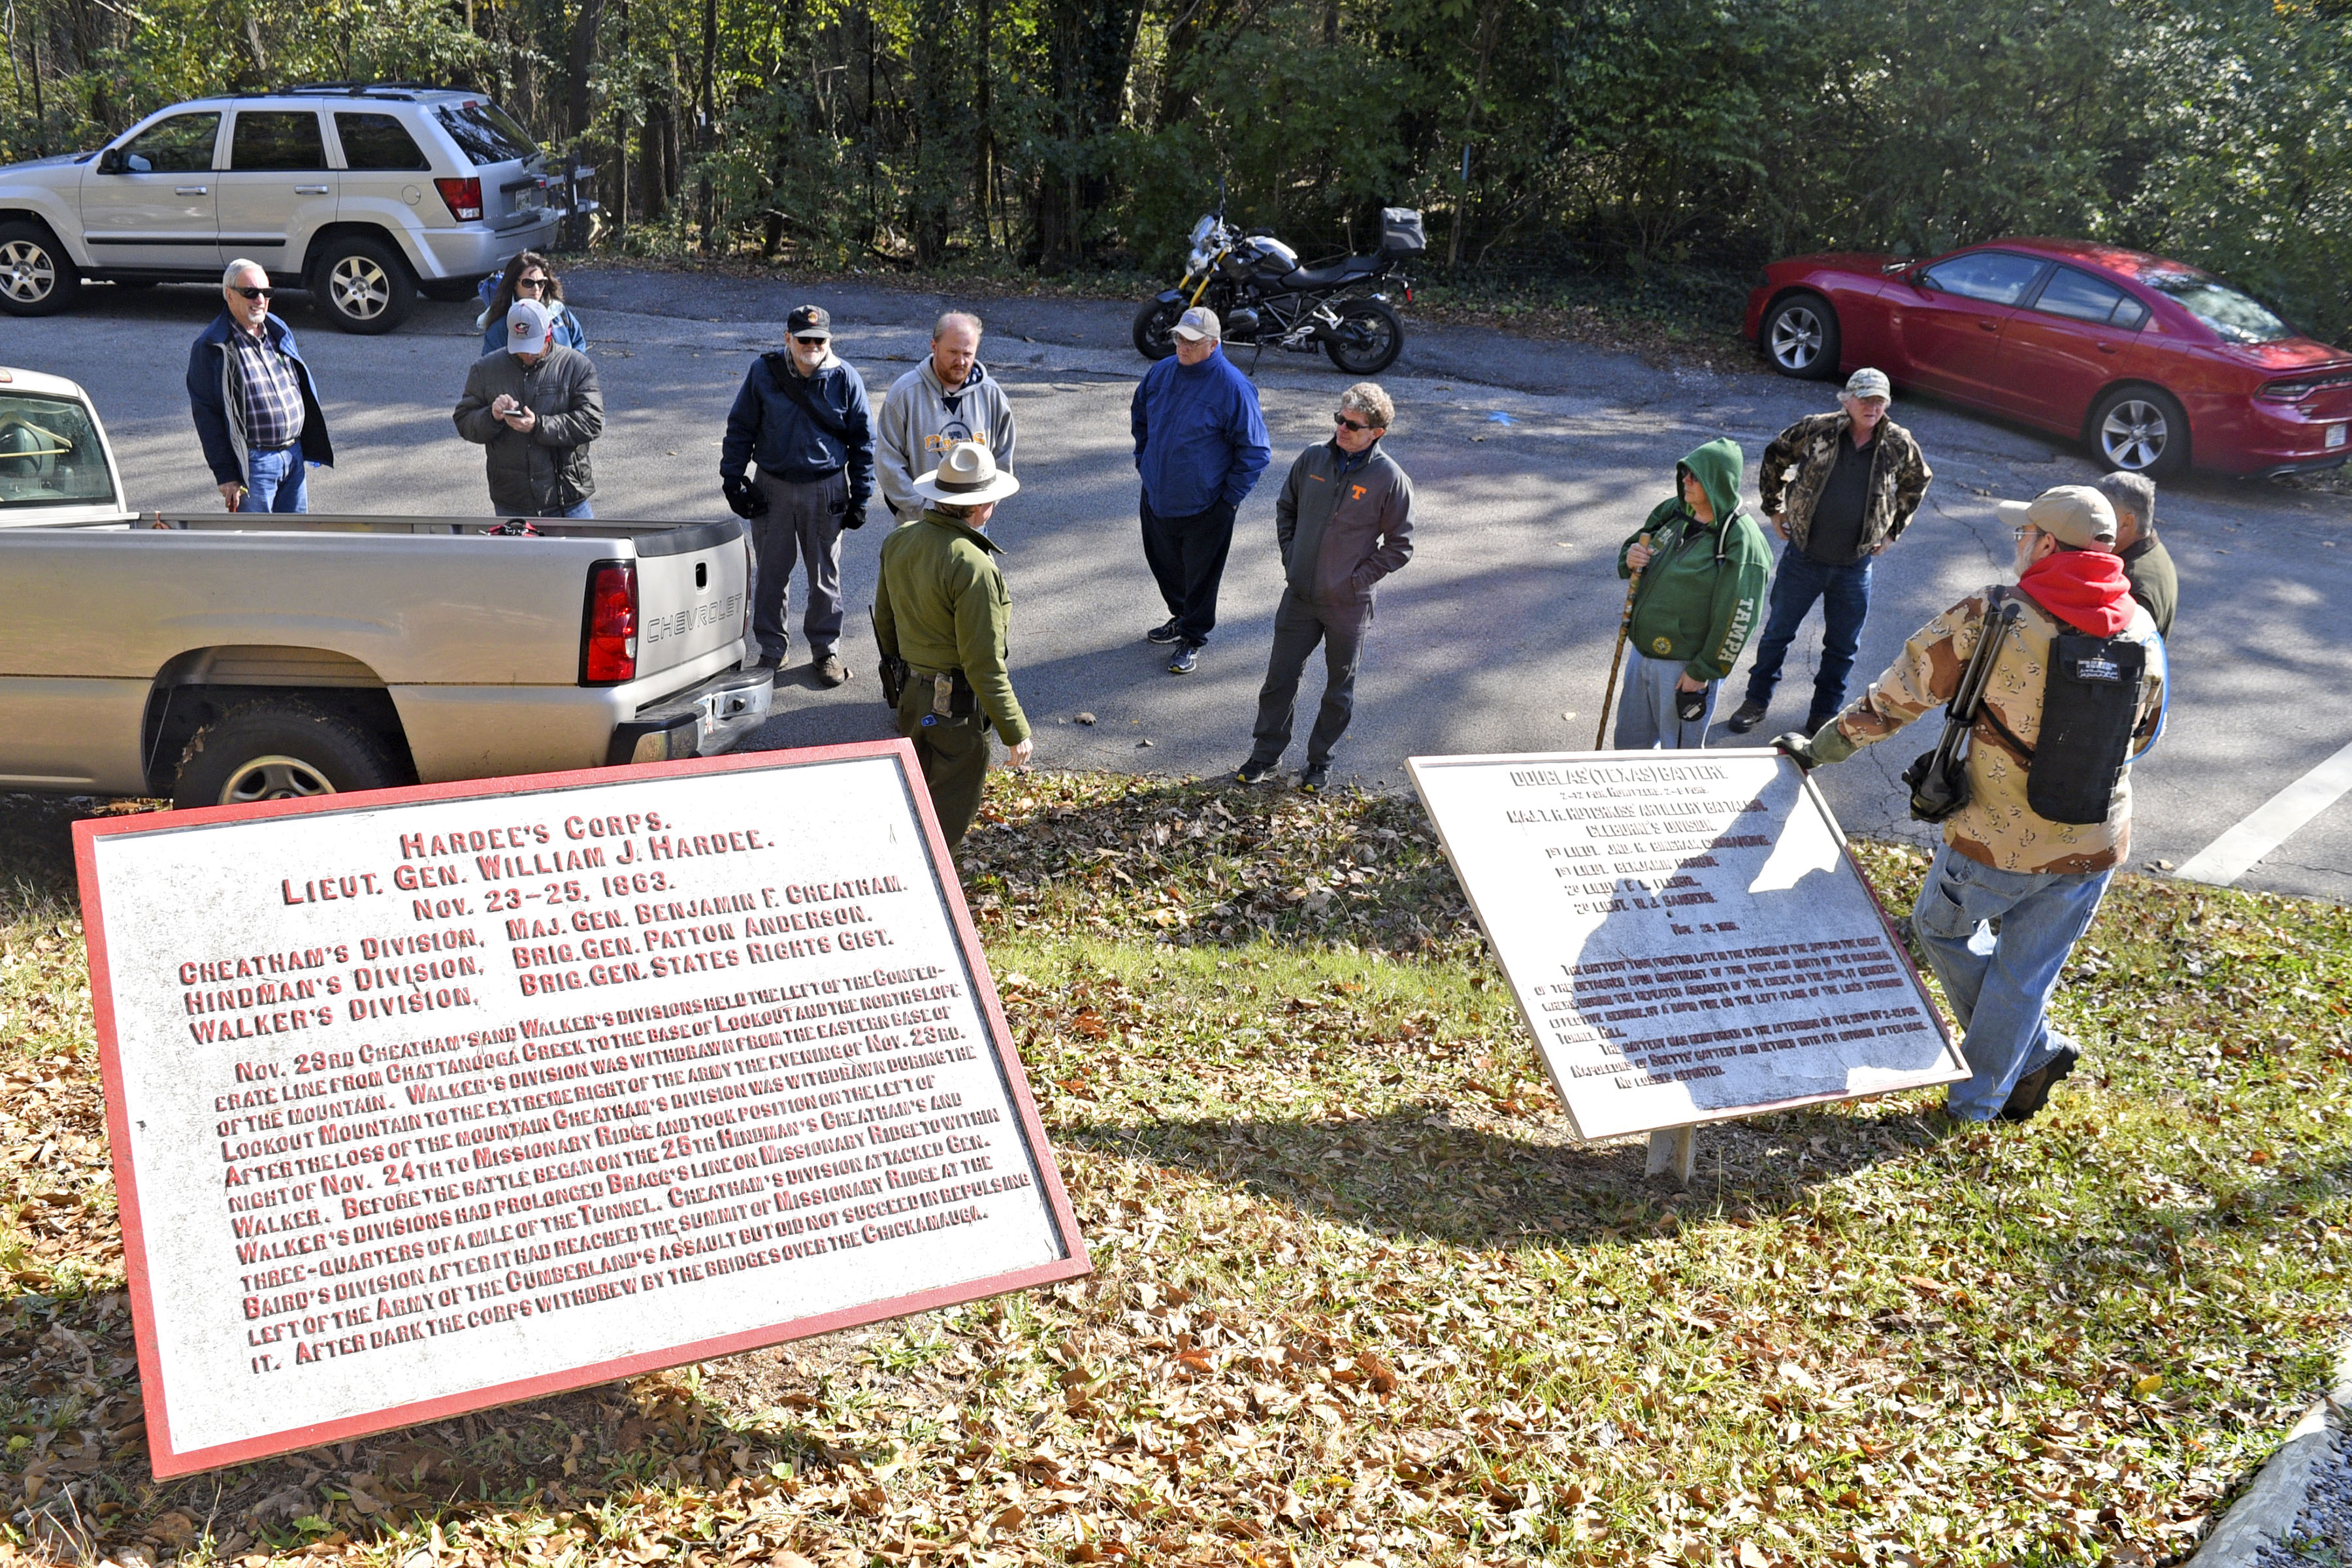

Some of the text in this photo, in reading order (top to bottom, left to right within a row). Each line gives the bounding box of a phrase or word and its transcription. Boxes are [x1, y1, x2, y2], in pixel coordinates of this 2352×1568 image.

[1352, 484, 1367, 500] T
[647, 593, 742, 643] CHEVROLET
[1718, 598, 1754, 663] TAMPA
[281, 830, 774, 906] LIEUT. GEN. WILLIAM J. HARDEE.
[399, 811, 672, 860] HARDEE'S CORPS.
[1615, 860, 1671, 872] BENJAMIN
[178, 875, 907, 986] CHEATHAM'S DIVISION, MAJ. GEN. BENJAMIN F. CHEATHAM.
[412, 871, 676, 921] NOV. 23-25, 1863.
[184, 906, 872, 1016] HINDMAN'S DIVISION, BRIG. GEN. PATTON ANDERSON.
[189, 1006, 333, 1045] WALKER'S
[519, 970, 588, 997] BRIG.
[588, 962, 648, 987] GEN.
[649, 949, 740, 978] STATES
[746, 936, 832, 964] RIGHTS
[837, 929, 894, 951] GIST.
[214, 1087, 278, 1113] ERATE
[281, 1079, 328, 1102] LINE
[329, 1071, 384, 1094] FROM
[385, 1049, 520, 1084] CHATTANOOGA
[521, 1039, 587, 1062] CREEK
[585, 1035, 610, 1053] TO
[609, 1030, 646, 1049] THE
[646, 1024, 692, 1043] BASE
[691, 1019, 712, 1037] OF
[713, 1007, 792, 1034] LOOKOUT
[795, 1003, 828, 1021] AND
[826, 998, 860, 1016] THE
[859, 990, 913, 1011] NORTH
[216, 1005, 950, 1138] OF THE MOUNTAIN. WALKER'S DIVISION WAS WITHDRAWN FROM THE EASTERN BASE OF
[234, 1061, 287, 1084] NOV.
[293, 1051, 355, 1075] 23RD
[358, 1031, 480, 1064] CHEATHAM'S
[480, 1026, 517, 1046] AND
[518, 1012, 615, 1039] WALKER'S
[615, 1000, 703, 1025] DIVISIONS
[703, 992, 747, 1012] HELD
[747, 988, 781, 1005] THE
[779, 982, 821, 1001] LEFT
[821, 979, 840, 994] OF
[842, 975, 875, 992] THE
[220, 1026, 966, 1163] LOOKOUT MOUNTAIN TO THE EXTREME RIGHT OF THE ARMY THE EVENING OF NOV. 23RD.
[224, 1045, 977, 1188] AFTER THE LOSS OF THE MOUNTAIN CHEATHAM'S DIVISION WAS WITHDRAWN DURING THE
[227, 1074, 936, 1214] NIGHT OF NOV. 24TH TO MISSIONARY RIDGE AND TOOK POSITION ON THE LEFT OF
